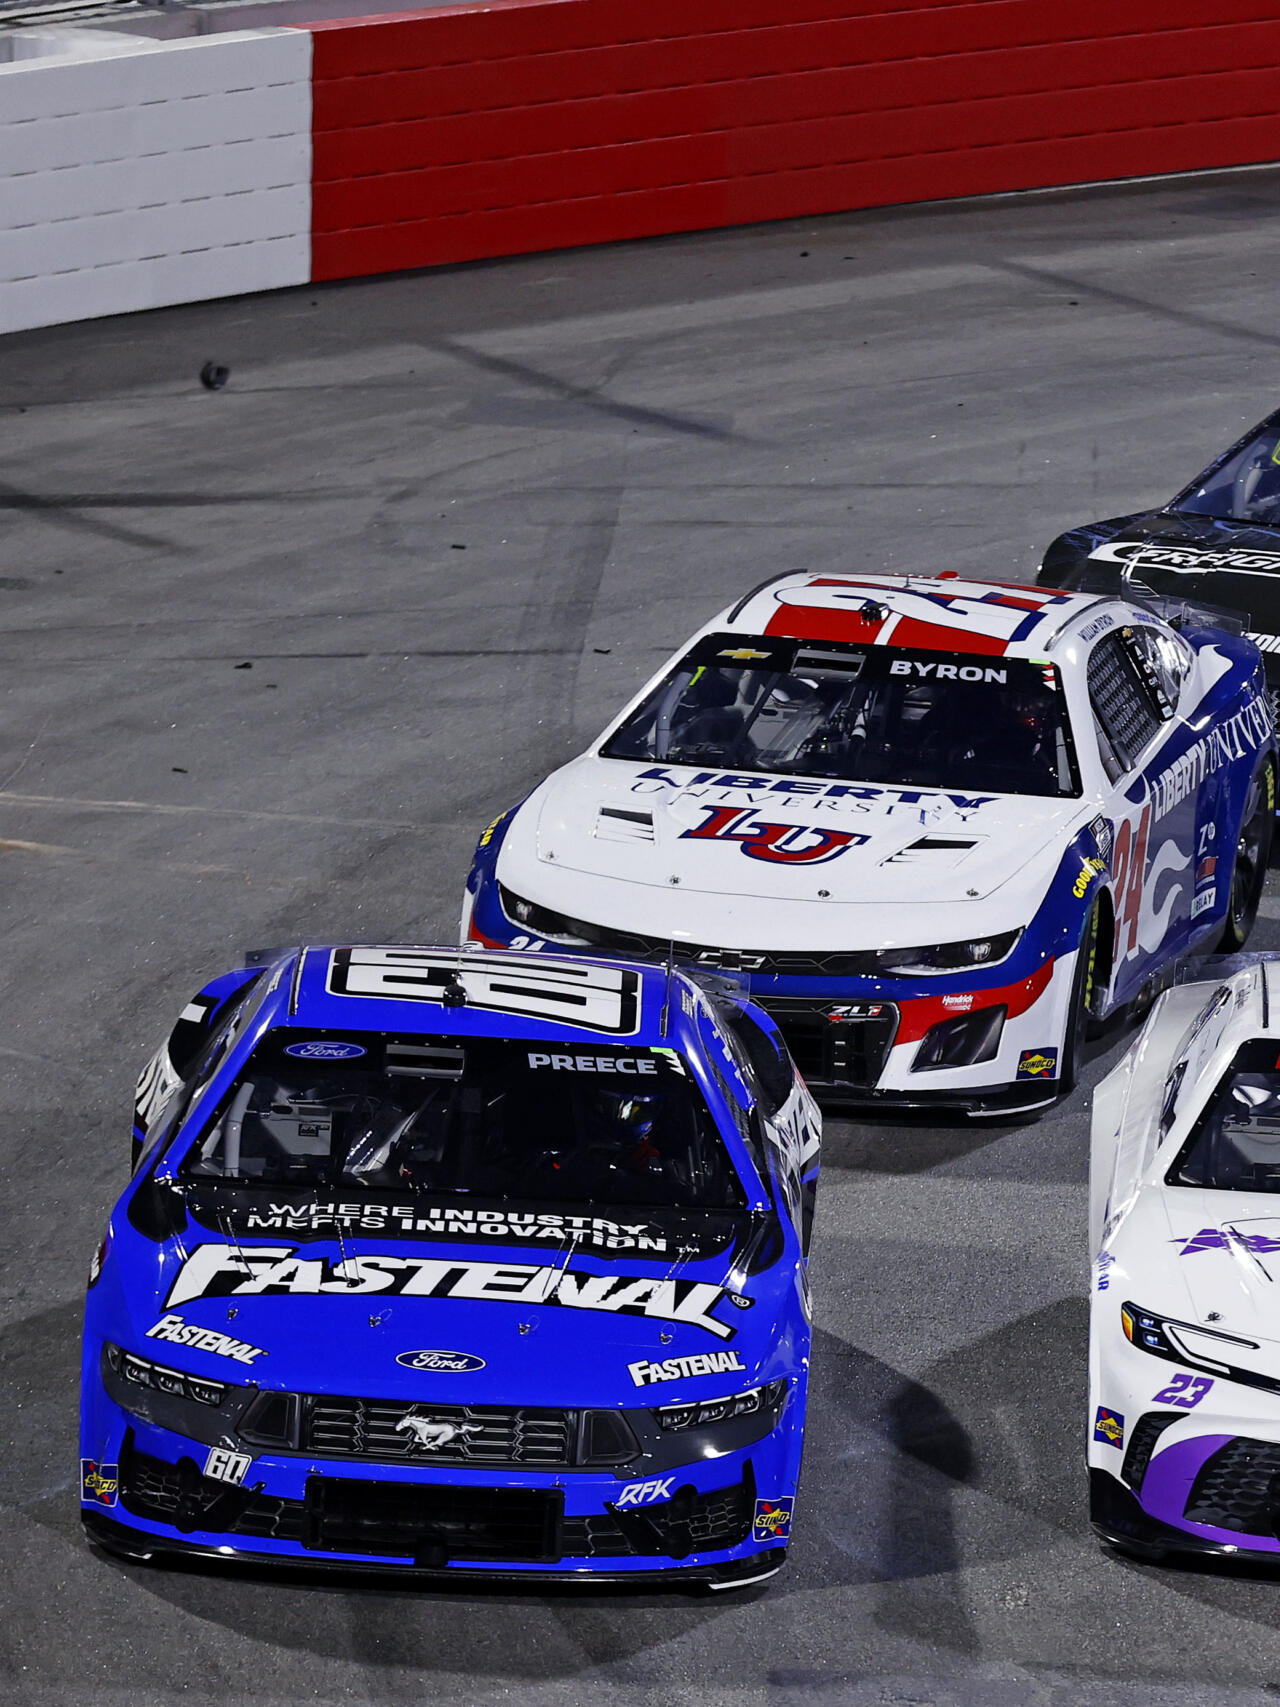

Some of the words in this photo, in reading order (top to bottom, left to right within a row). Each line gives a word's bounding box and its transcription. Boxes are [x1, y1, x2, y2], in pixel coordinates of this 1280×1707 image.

[889, 660, 1007, 684] BYRON
[633, 767, 1002, 809] LIBERTY
[527, 1052, 658, 1076] PREECE
[1019, 1059, 1056, 1072] SUNOCO
[267, 1203, 414, 1219] WHERE
[429, 1208, 649, 1237] INDUSTRY
[401, 1218, 668, 1253] INNOVATION
[165, 1244, 734, 1340] FASTENAL
[145, 1314, 264, 1366] FASTENAL
[411, 1352, 469, 1371] Ford
[626, 1350, 746, 1388] FASTENAL
[1151, 1373, 1215, 1409] 23
[1095, 1419, 1124, 1439] SUNOCO
[206, 1450, 249, 1484] 60
[616, 1476, 677, 1507] RFK
